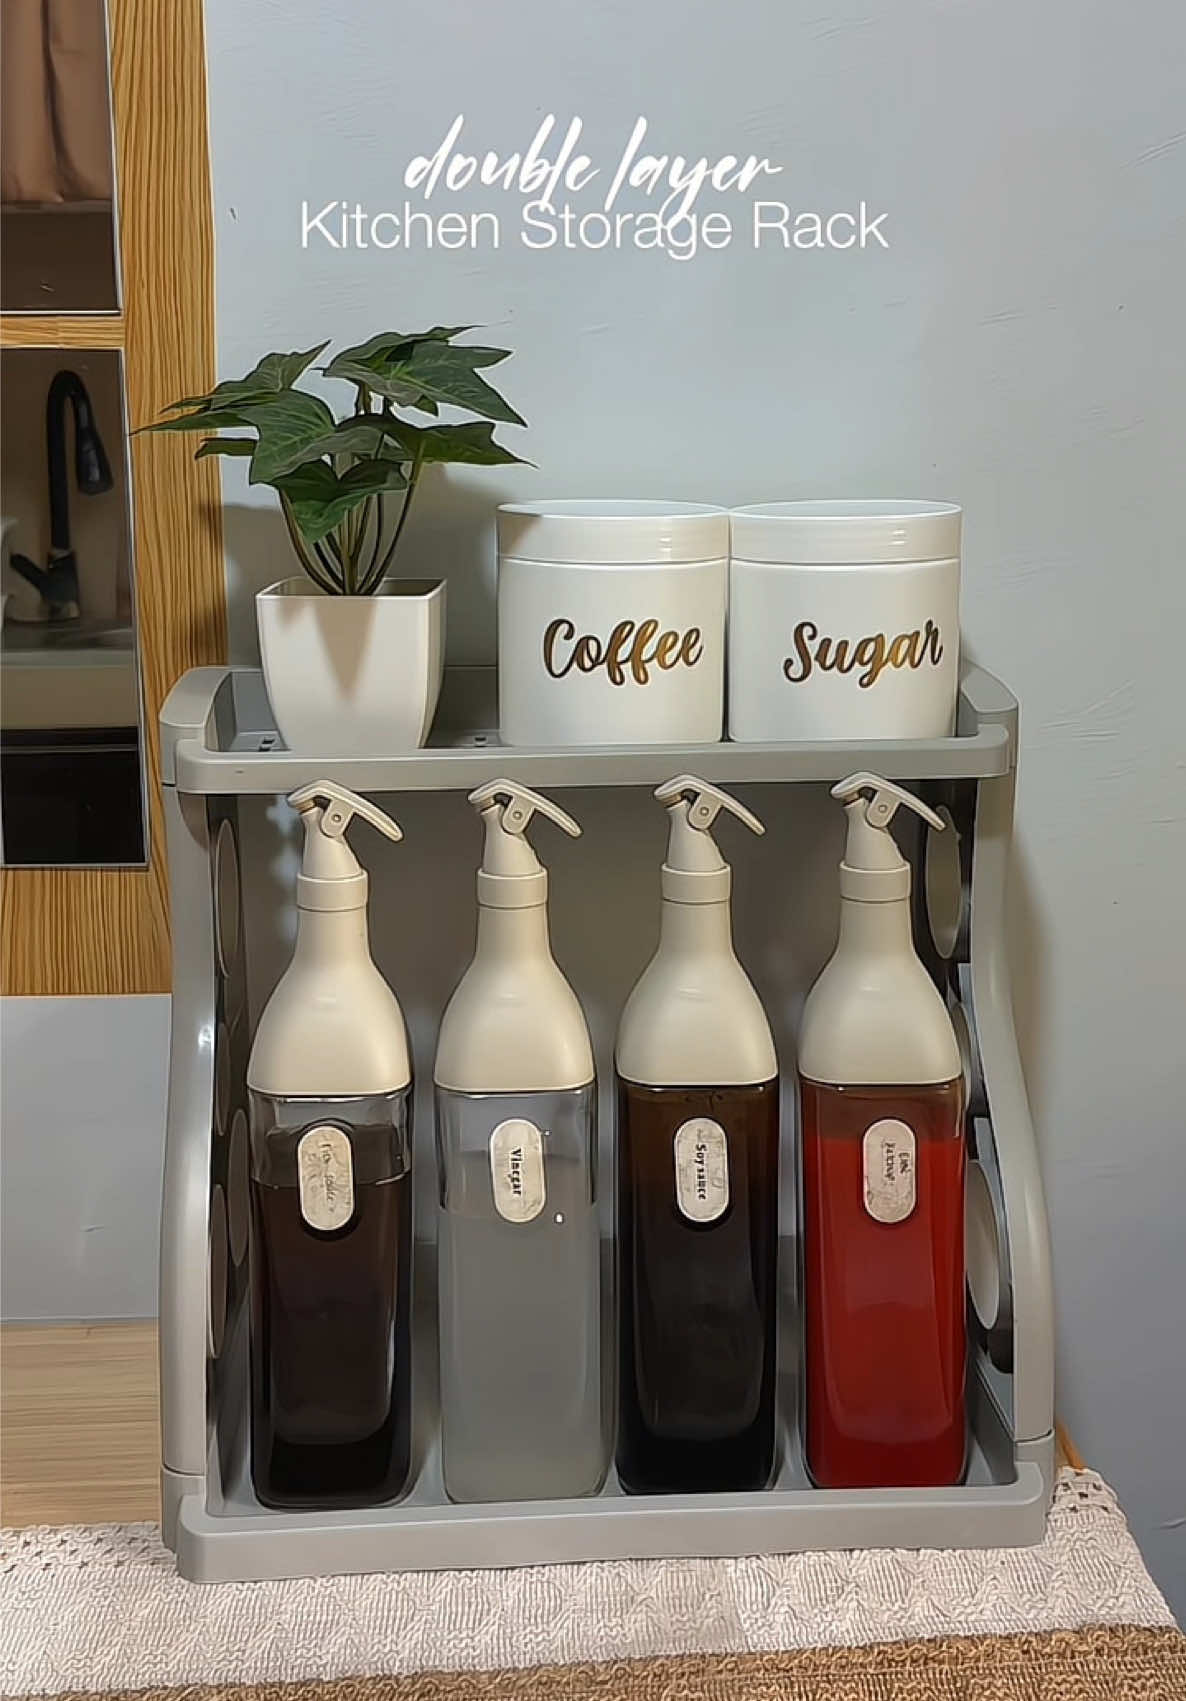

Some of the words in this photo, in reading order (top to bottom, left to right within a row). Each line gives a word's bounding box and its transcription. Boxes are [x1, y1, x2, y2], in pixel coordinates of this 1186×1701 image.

[542, 617, 705, 687] Coffee
[782, 618, 944, 689] Sugar
[508, 1147, 522, 1196] Vinegar
[694, 1143, 707, 1167] Soy
